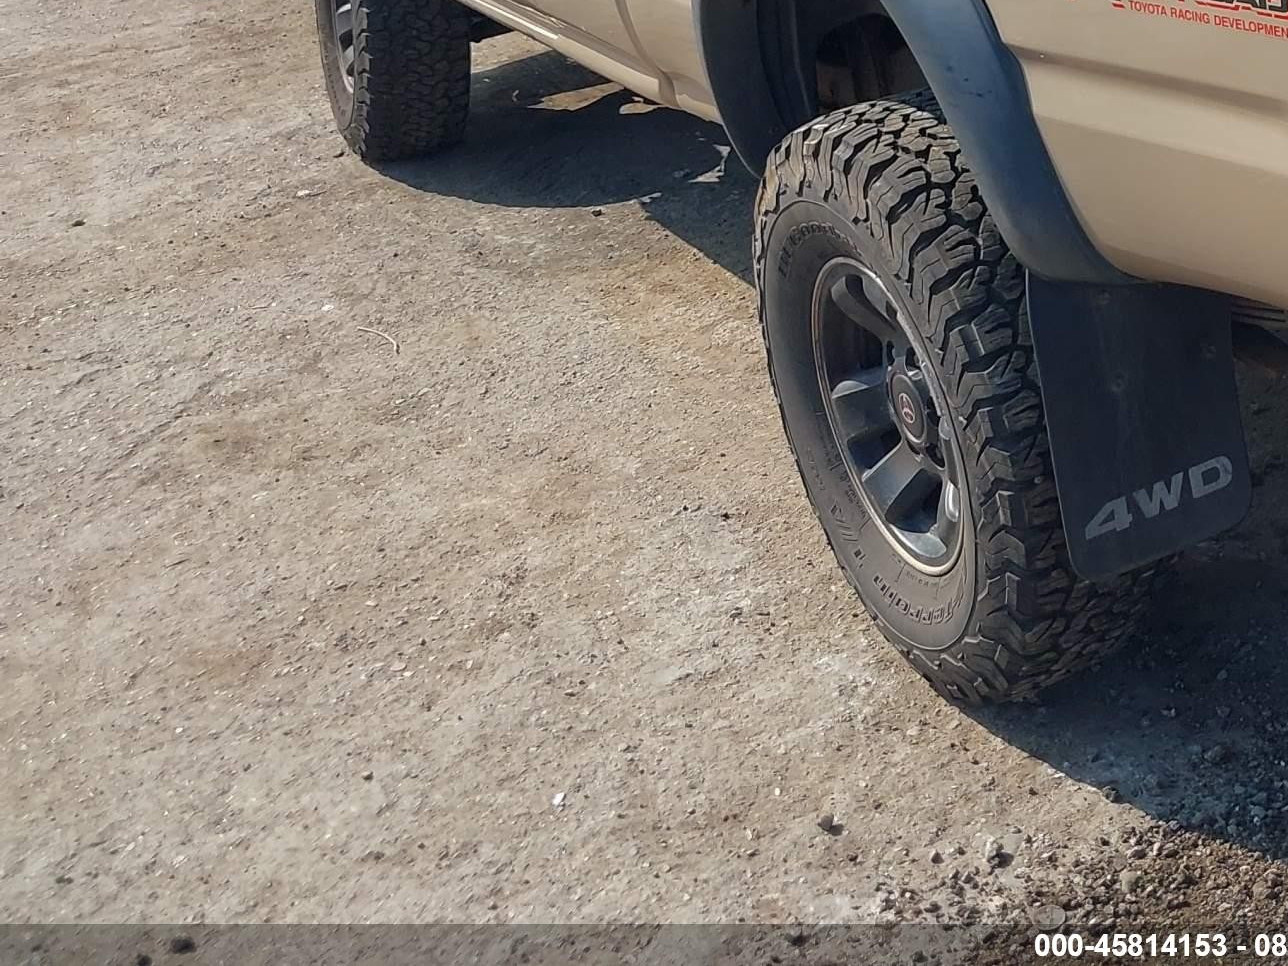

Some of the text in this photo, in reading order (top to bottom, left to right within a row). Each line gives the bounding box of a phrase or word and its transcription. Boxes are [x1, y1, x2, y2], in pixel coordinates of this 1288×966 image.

[1128, 0, 1168, 17] TOYOTA
[1170, 7, 1210, 25] RACING
[1085, 455, 1232, 540] 4WD
